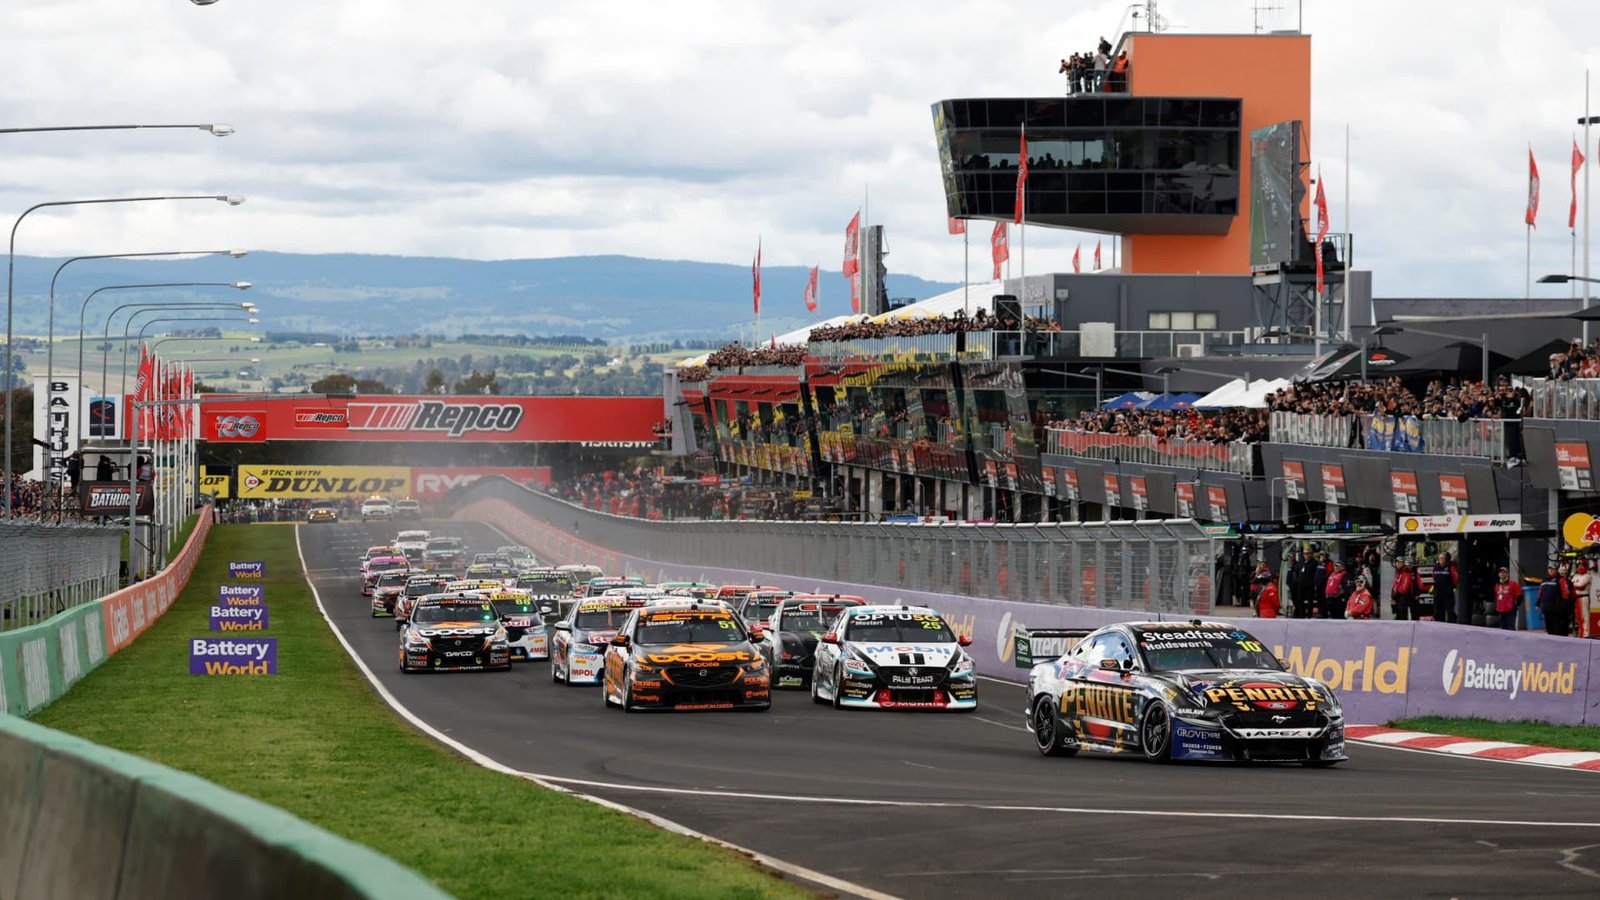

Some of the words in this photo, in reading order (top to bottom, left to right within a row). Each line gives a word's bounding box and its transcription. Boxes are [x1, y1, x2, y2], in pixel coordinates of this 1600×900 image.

[315, 412, 346, 424] Repco
[414, 400, 522, 437] Repco
[264, 478, 405, 493] DUNLOP
[90, 493, 142, 507] BATHURT
[1490, 519, 1516, 527] Repco
[230, 562, 262, 570] Battery
[220, 585, 260, 597] Battery
[226, 597, 260, 606] World
[211, 606, 263, 620] Battery
[219, 620, 262, 631] World
[718, 620, 737, 629] 51
[921, 621, 942, 630] 25
[418, 628, 495, 636] boost
[1142, 630, 1232, 641] Steadfast
[193, 639, 270, 660] Battery
[866, 646, 951, 655] Mobil
[1146, 641, 1213, 651] Holdsworth
[1236, 640, 1264, 653] 10
[647, 651, 749, 662] boost
[205, 661, 268, 676] World
[1272, 644, 1411, 695] World
[1204, 686, 1326, 703] PENRITE
[1061, 681, 1134, 724] PENRITE
[1176, 728, 1207, 740] GROVE
[1254, 729, 1303, 737] APEX
